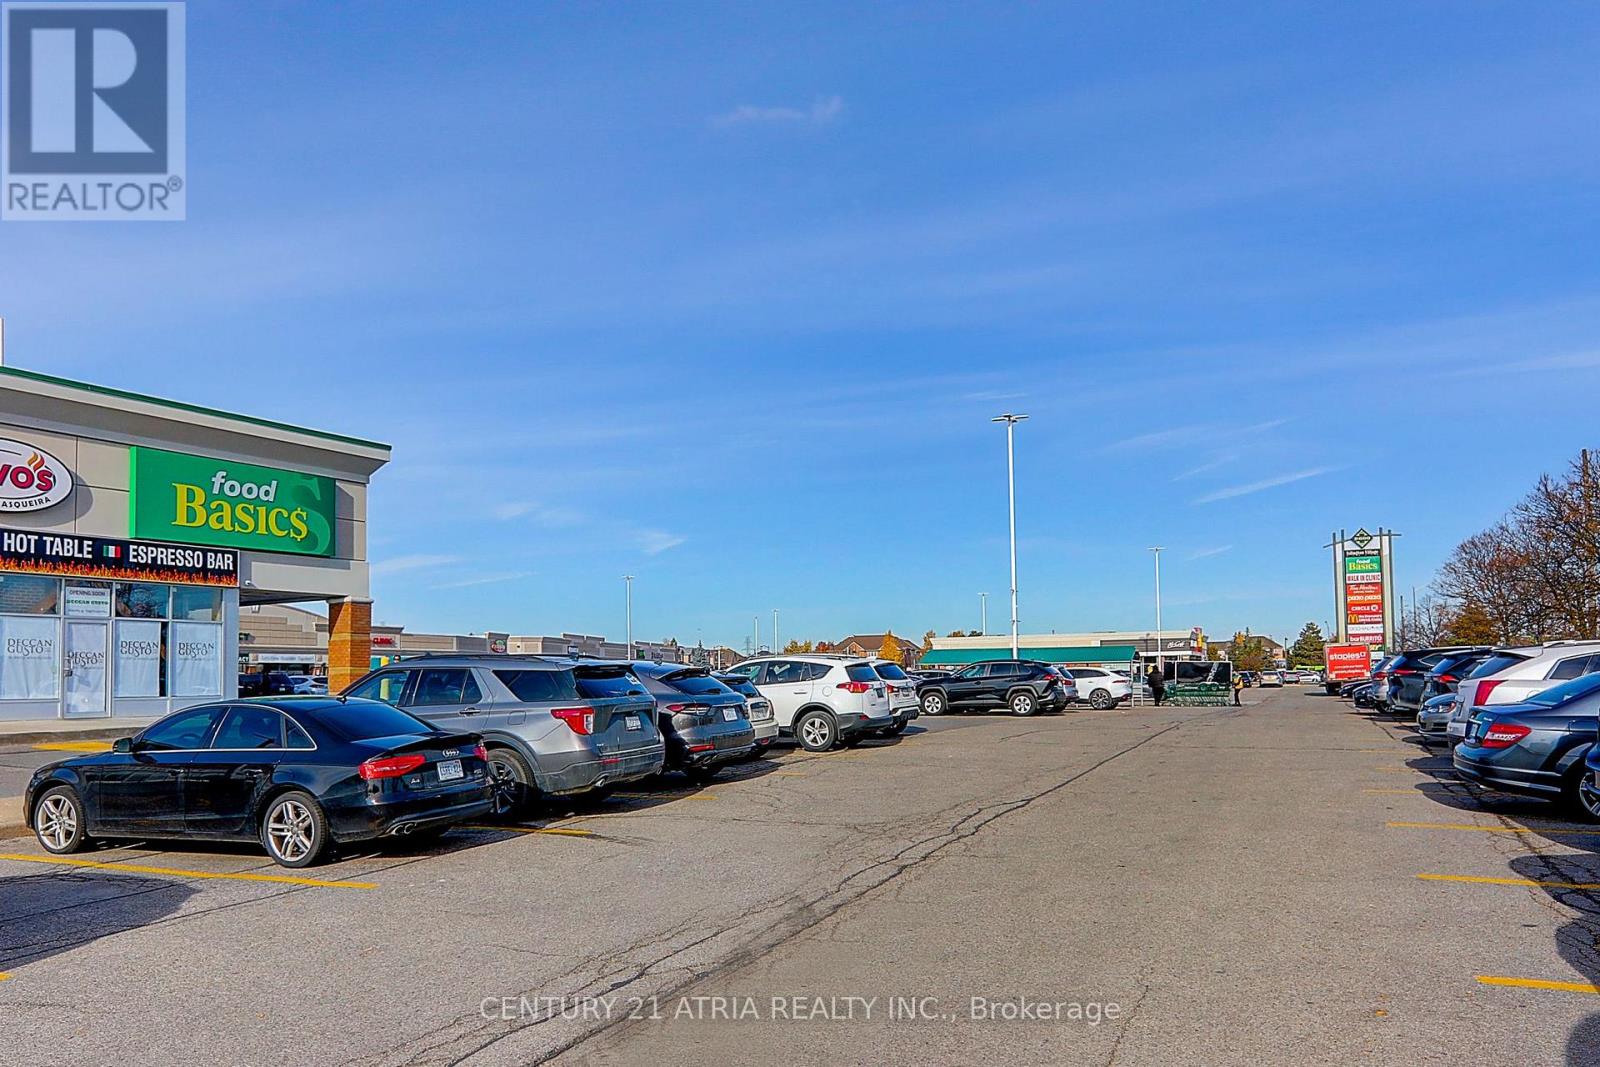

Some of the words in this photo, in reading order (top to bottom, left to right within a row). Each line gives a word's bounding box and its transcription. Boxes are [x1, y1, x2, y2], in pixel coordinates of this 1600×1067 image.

[211, 471, 278, 502] food
[3, 532, 38, 554] HOT
[43, 536, 93, 559] TABLE
[129, 544, 203, 568] ESPRESSO
[207, 552, 233, 570] BAR
[7, 638, 52, 647] DECCAN
[120, 640, 159, 648] DECCAN
[178, 642, 214, 650] DECCAN
[7, 645, 44, 656] GUSTO
[120, 647, 152, 657] GUSTO
[178, 649, 208, 658] GUSTO
